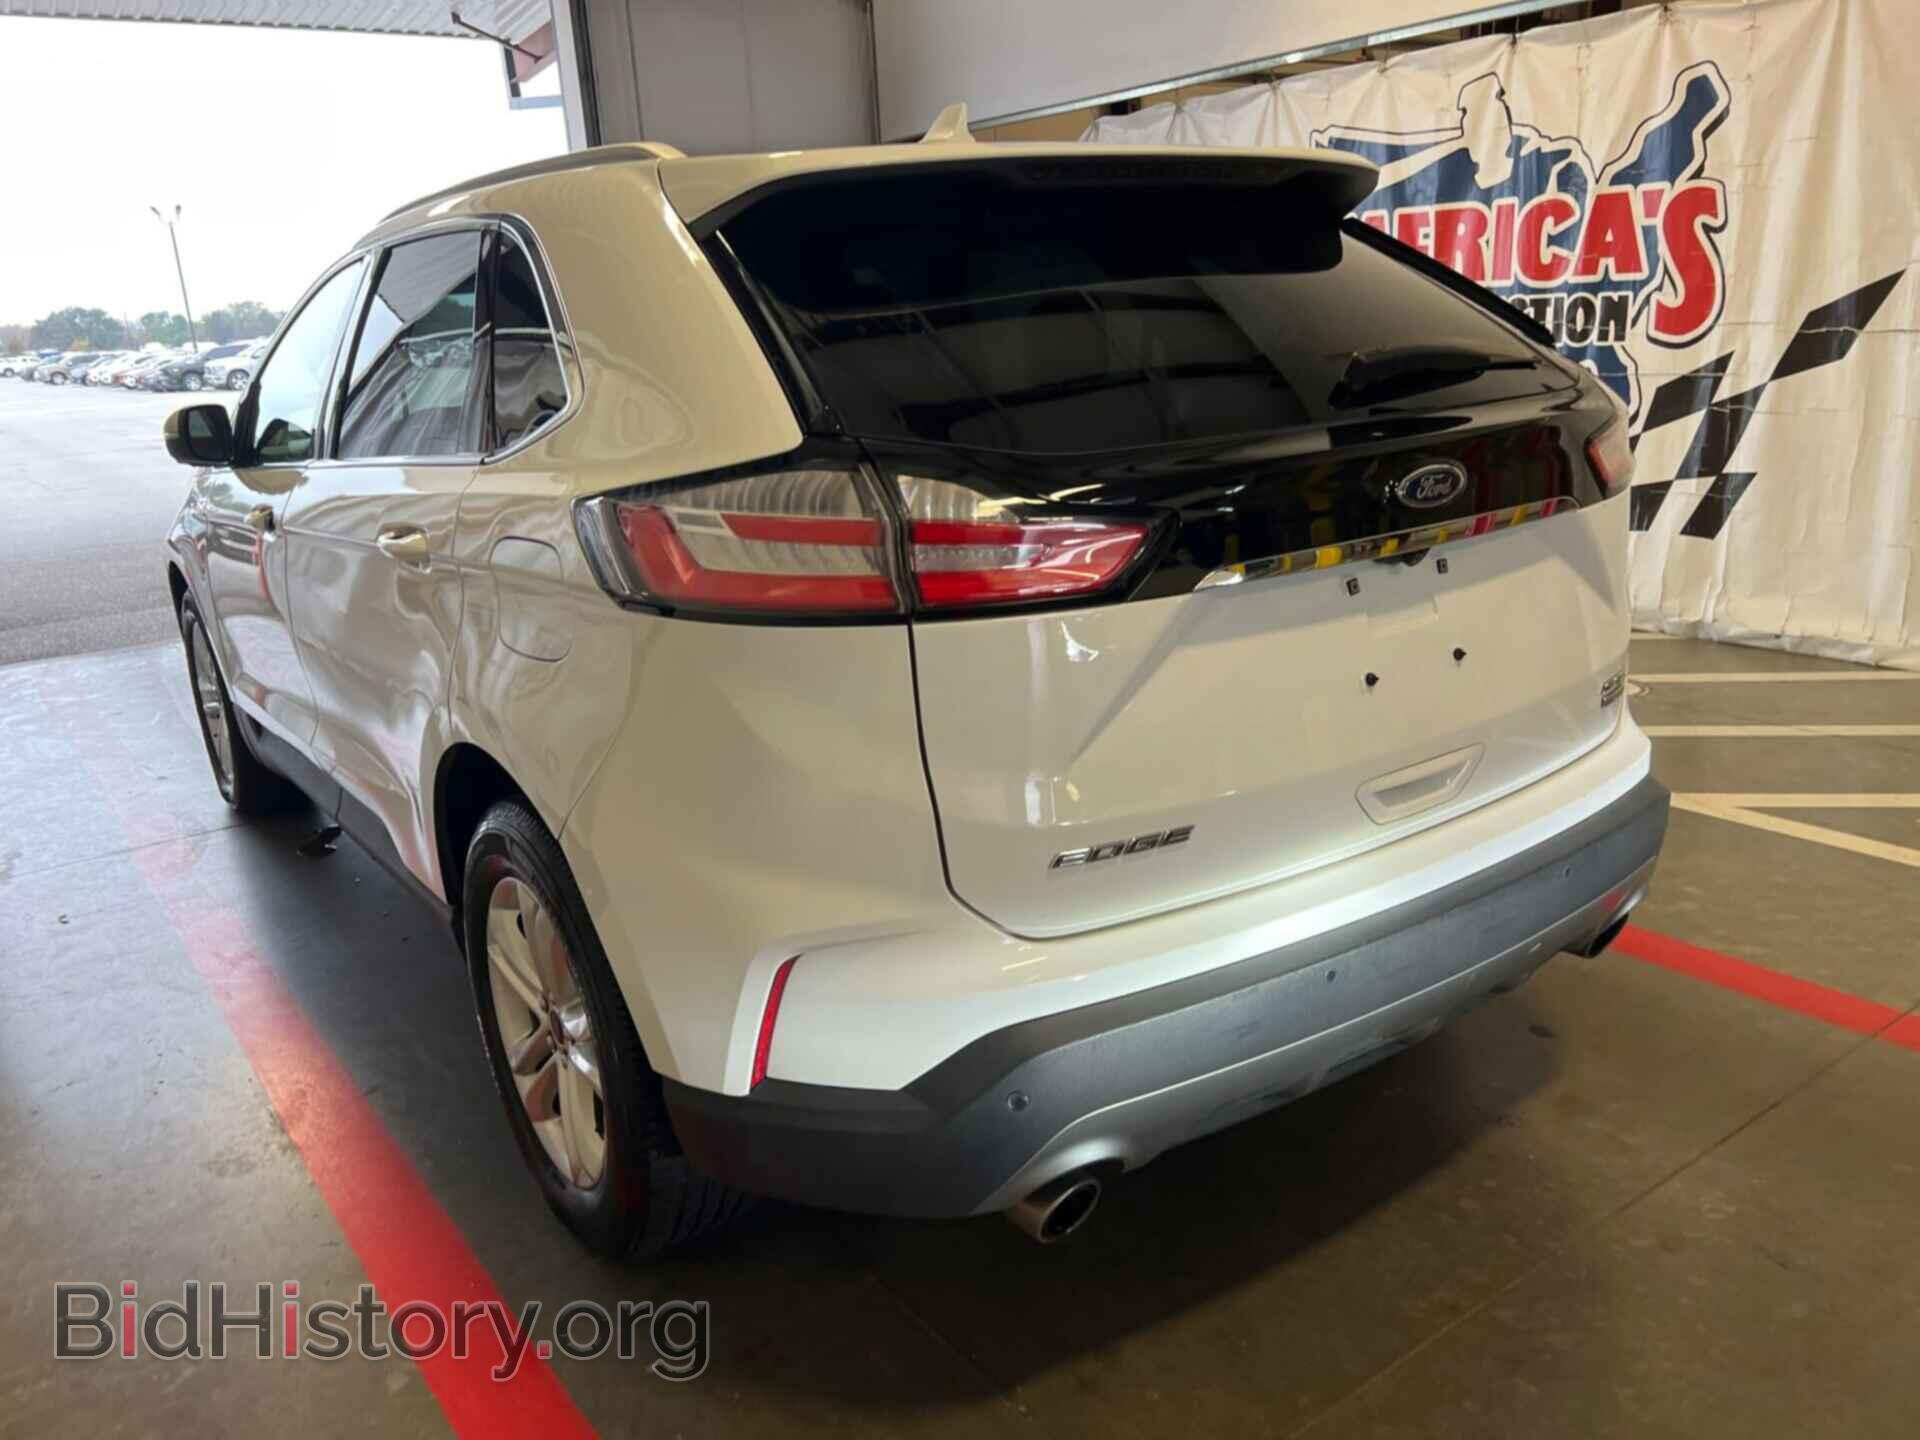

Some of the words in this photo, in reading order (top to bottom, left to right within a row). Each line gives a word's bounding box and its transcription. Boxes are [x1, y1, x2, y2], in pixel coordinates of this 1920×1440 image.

[1345, 180, 1725, 344] ERICA'S
[1416, 472, 1454, 499] Ford
[1049, 825, 1196, 869] EDGE
